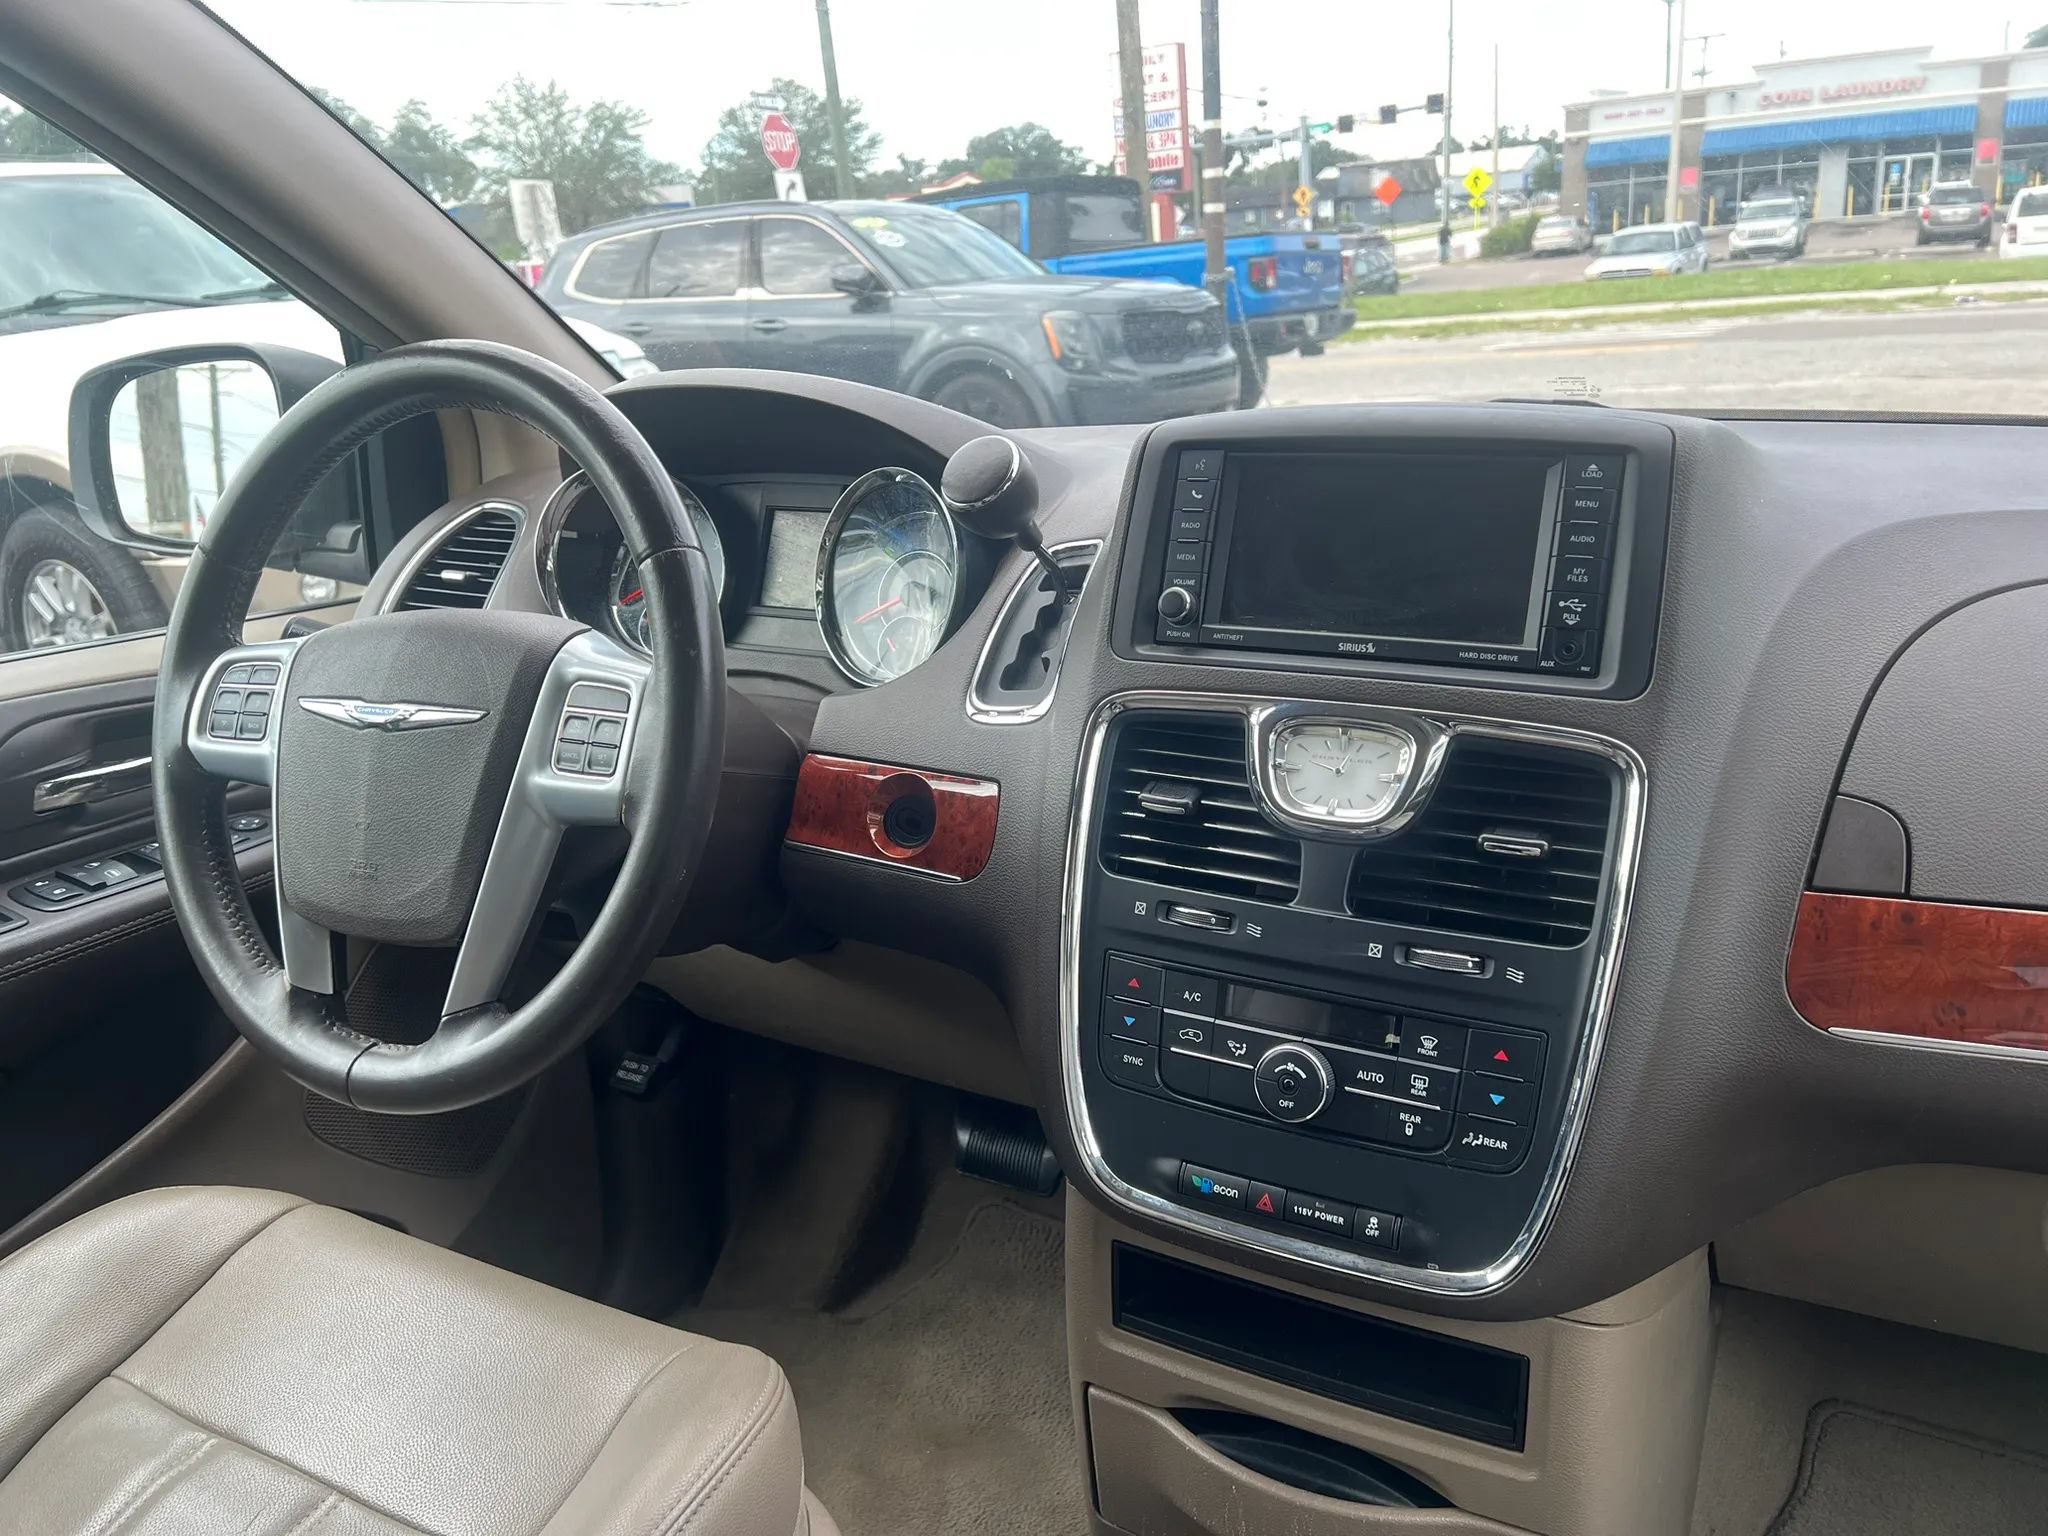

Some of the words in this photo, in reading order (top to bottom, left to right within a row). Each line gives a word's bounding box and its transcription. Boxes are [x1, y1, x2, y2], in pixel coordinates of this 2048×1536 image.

[1760, 89, 1812, 106] COIN
[1821, 77, 1928, 103] LAUNDRY
[765, 130, 796, 153] STOP
[1575, 500, 1599, 508] MENU
[1569, 535, 1596, 543] AUDIO
[1573, 567, 1585, 575] MY
[1173, 578, 1196, 586] VOLUME
[1567, 574, 1589, 583] FILES
[1563, 613, 1581, 621] PULL
[1213, 633, 1244, 641] ANTITHEFT
[1338, 641, 1367, 653] SIRIUS
[1459, 650, 1478, 660] HARD
[1480, 652, 1497, 661] DISC
[1497, 653, 1519, 663] DRIVE
[1183, 990, 1202, 1003] A/C
[1417, 1047, 1438, 1058] FRONT
[1123, 1054, 1144, 1067] SYNC
[1356, 1070, 1384, 1084] AUTO
[1410, 1087, 1427, 1097] REAR
[1278, 1099, 1294, 1109] OFF
[1399, 1112, 1422, 1124] REAR
[1483, 1137, 1508, 1151] REAR
[1213, 1184, 1239, 1200] econ
[1293, 1204, 1312, 1218] 115V
[1315, 1210, 1344, 1226] POWER
[1365, 1227, 1380, 1239] OFF
